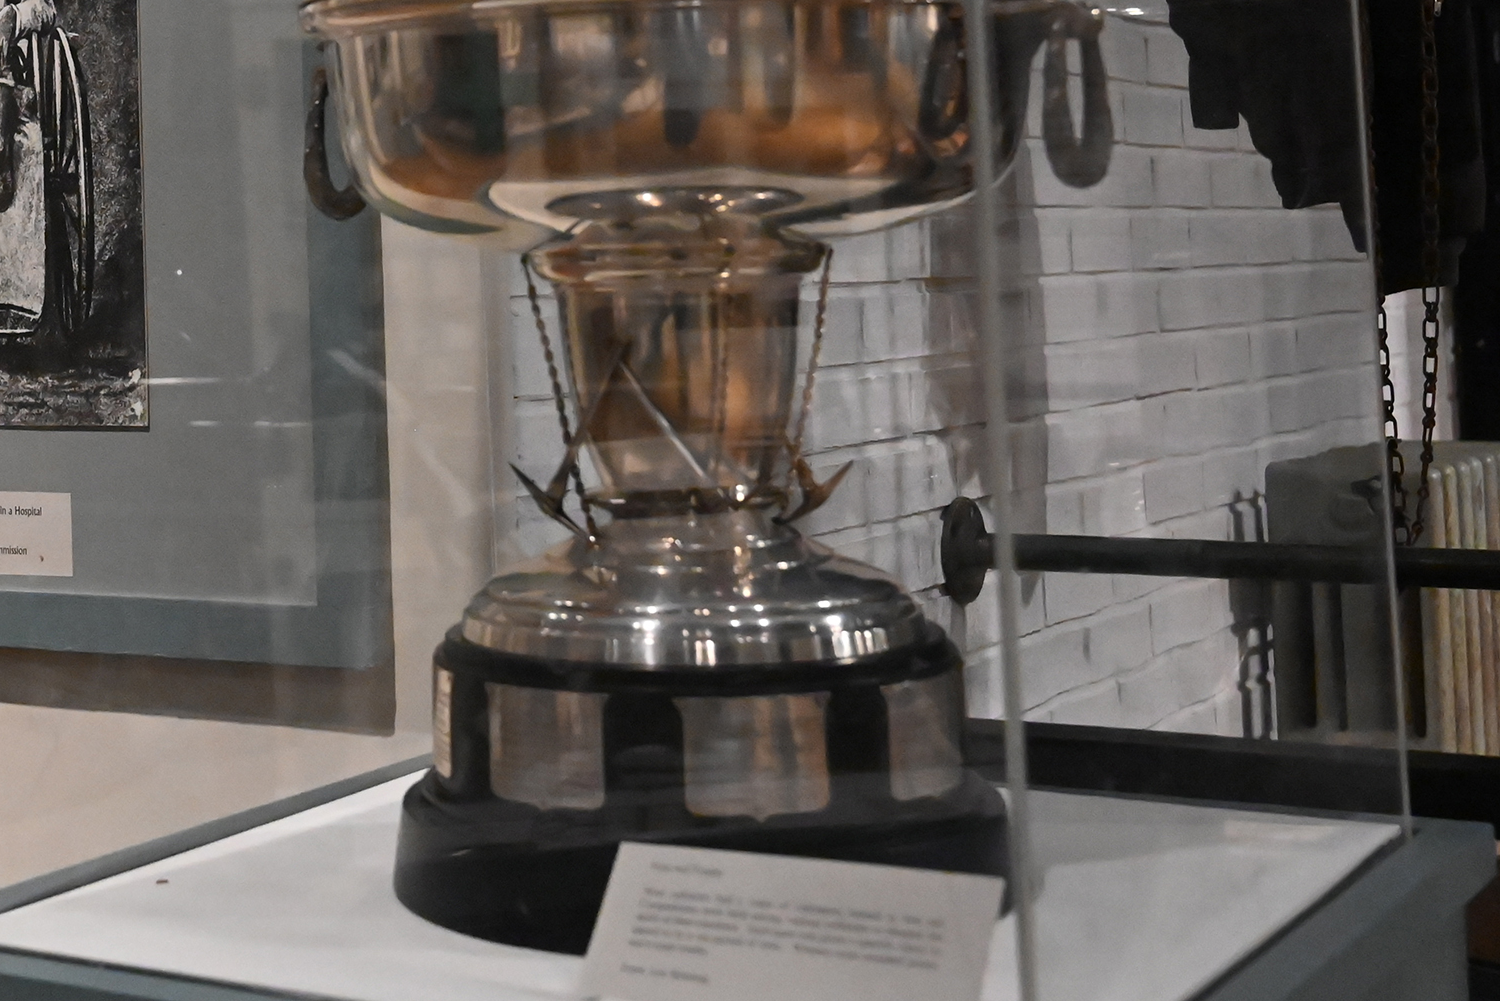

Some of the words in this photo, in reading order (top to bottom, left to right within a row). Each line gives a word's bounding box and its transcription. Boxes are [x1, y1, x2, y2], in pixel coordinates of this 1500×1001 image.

[0, 505, 7, 515] in
[7, 507, 13, 516] a
[14, 505, 42, 518] Hospital
